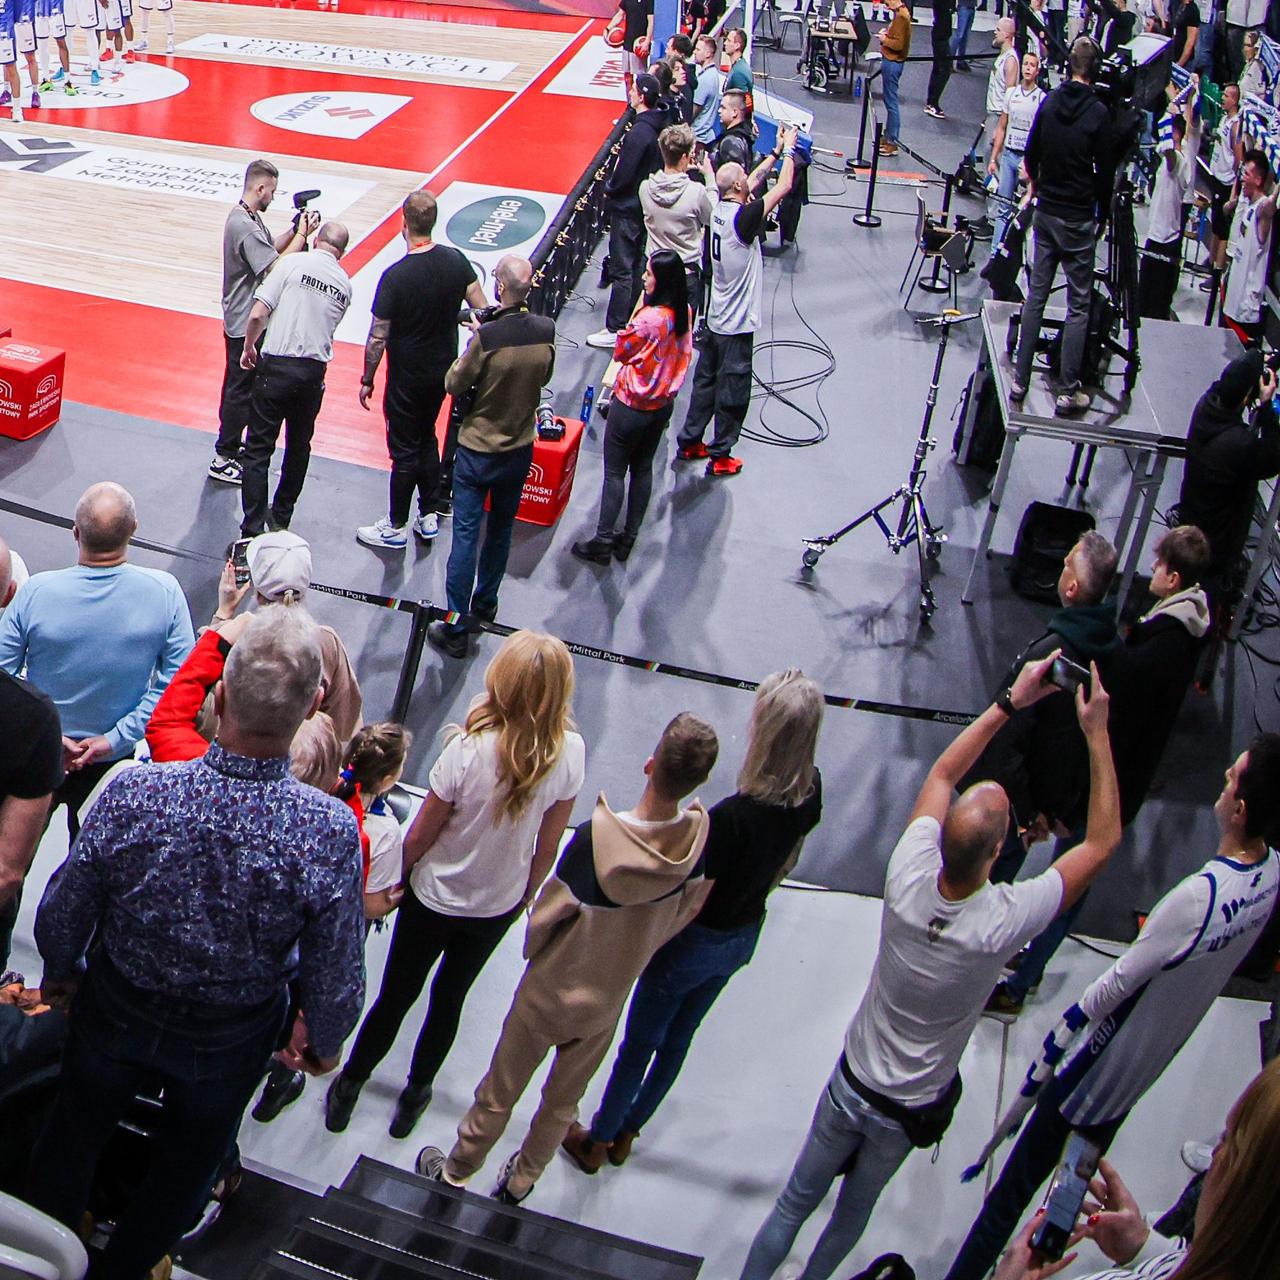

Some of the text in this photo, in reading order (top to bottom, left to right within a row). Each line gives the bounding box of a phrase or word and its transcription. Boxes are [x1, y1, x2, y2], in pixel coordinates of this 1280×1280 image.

[202, 40, 490, 74] AEROWATCH
[275, 95, 332, 122] SUZUKI
[78, 168, 220, 196] Metropolia
[468, 199, 523, 247] enel-med
[346, 589, 368, 602] Park
[603, 652, 625, 664] Park
